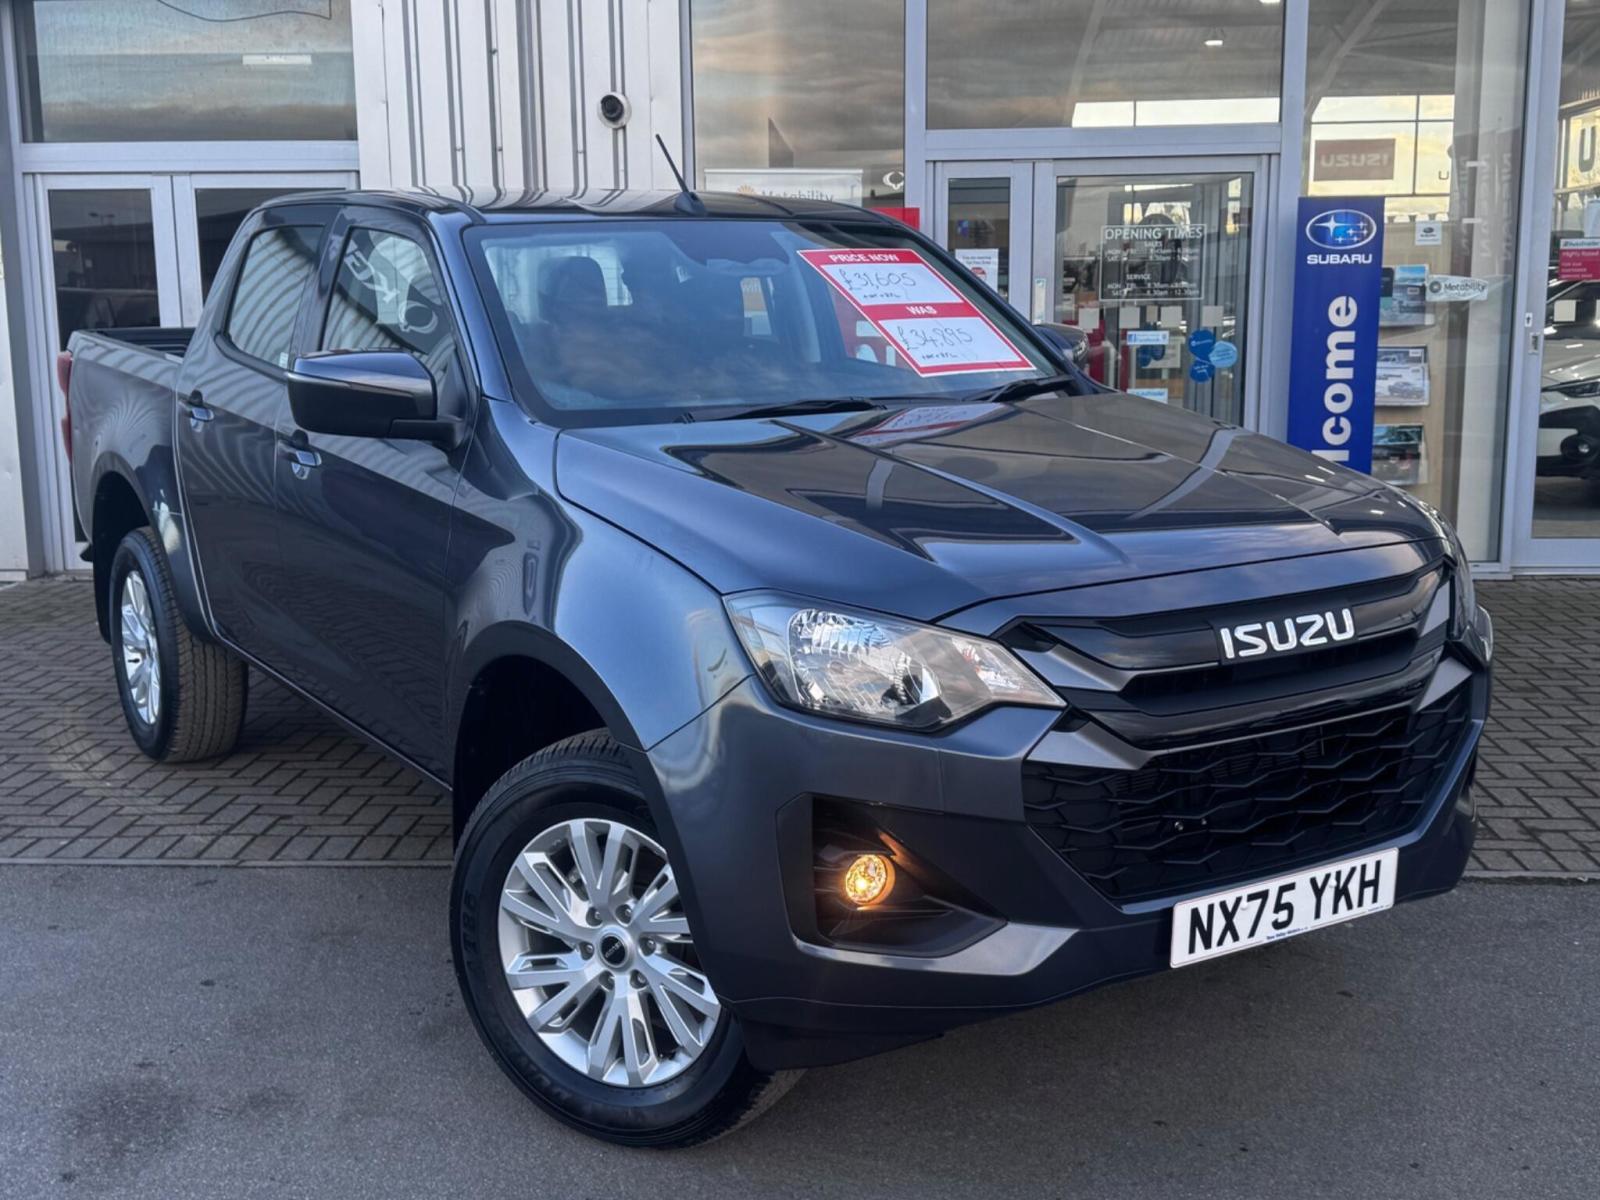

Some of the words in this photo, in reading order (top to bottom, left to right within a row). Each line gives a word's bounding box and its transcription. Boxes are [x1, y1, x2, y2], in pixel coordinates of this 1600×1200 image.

[1105, 227, 1161, 240] OPENING
[1166, 226, 1203, 239] TIMES
[828, 253, 870, 263] PRICE
[867, 253, 900, 262] NOW
[1307, 253, 1373, 264] SUBARU
[839, 264, 916, 290] £31,605
[905, 304, 938, 315] WAS
[897, 326, 973, 350] £34,895
[1220, 608, 1355, 659] ISUZU
[1188, 881, 1296, 954] NX75
[1309, 859, 1381, 920] YKH
